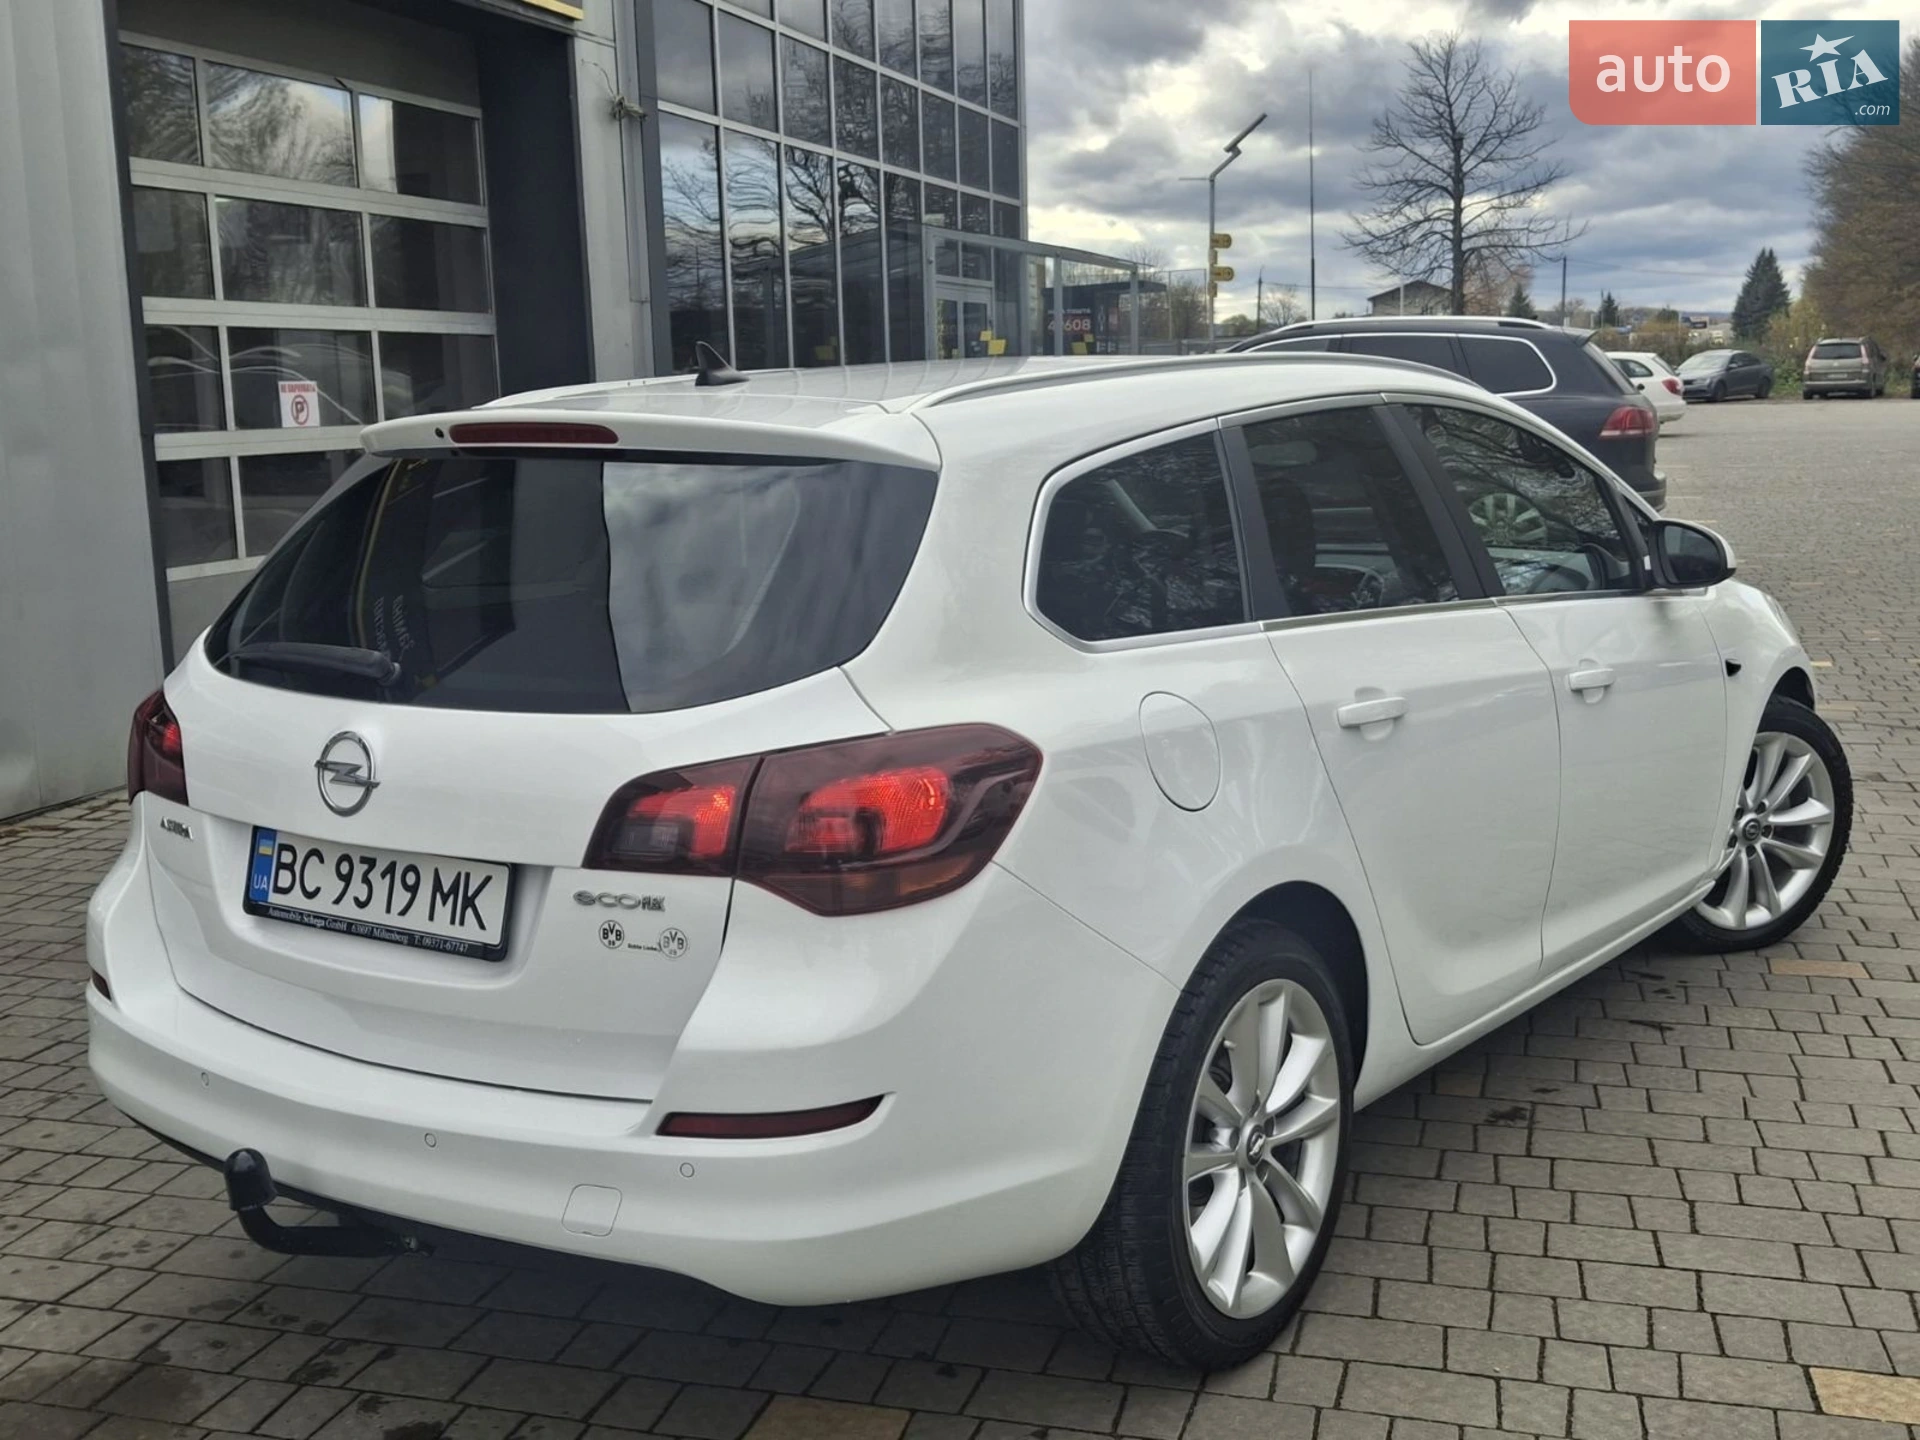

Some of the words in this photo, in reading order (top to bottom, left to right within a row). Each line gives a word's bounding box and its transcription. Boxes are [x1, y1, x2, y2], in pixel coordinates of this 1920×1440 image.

[253, 875, 268, 891] UA
[272, 842, 325, 900] BC
[331, 853, 421, 917] 9319
[428, 867, 493, 931] MK
[602, 922, 623, 942] BVB
[663, 930, 685, 950] BVB
